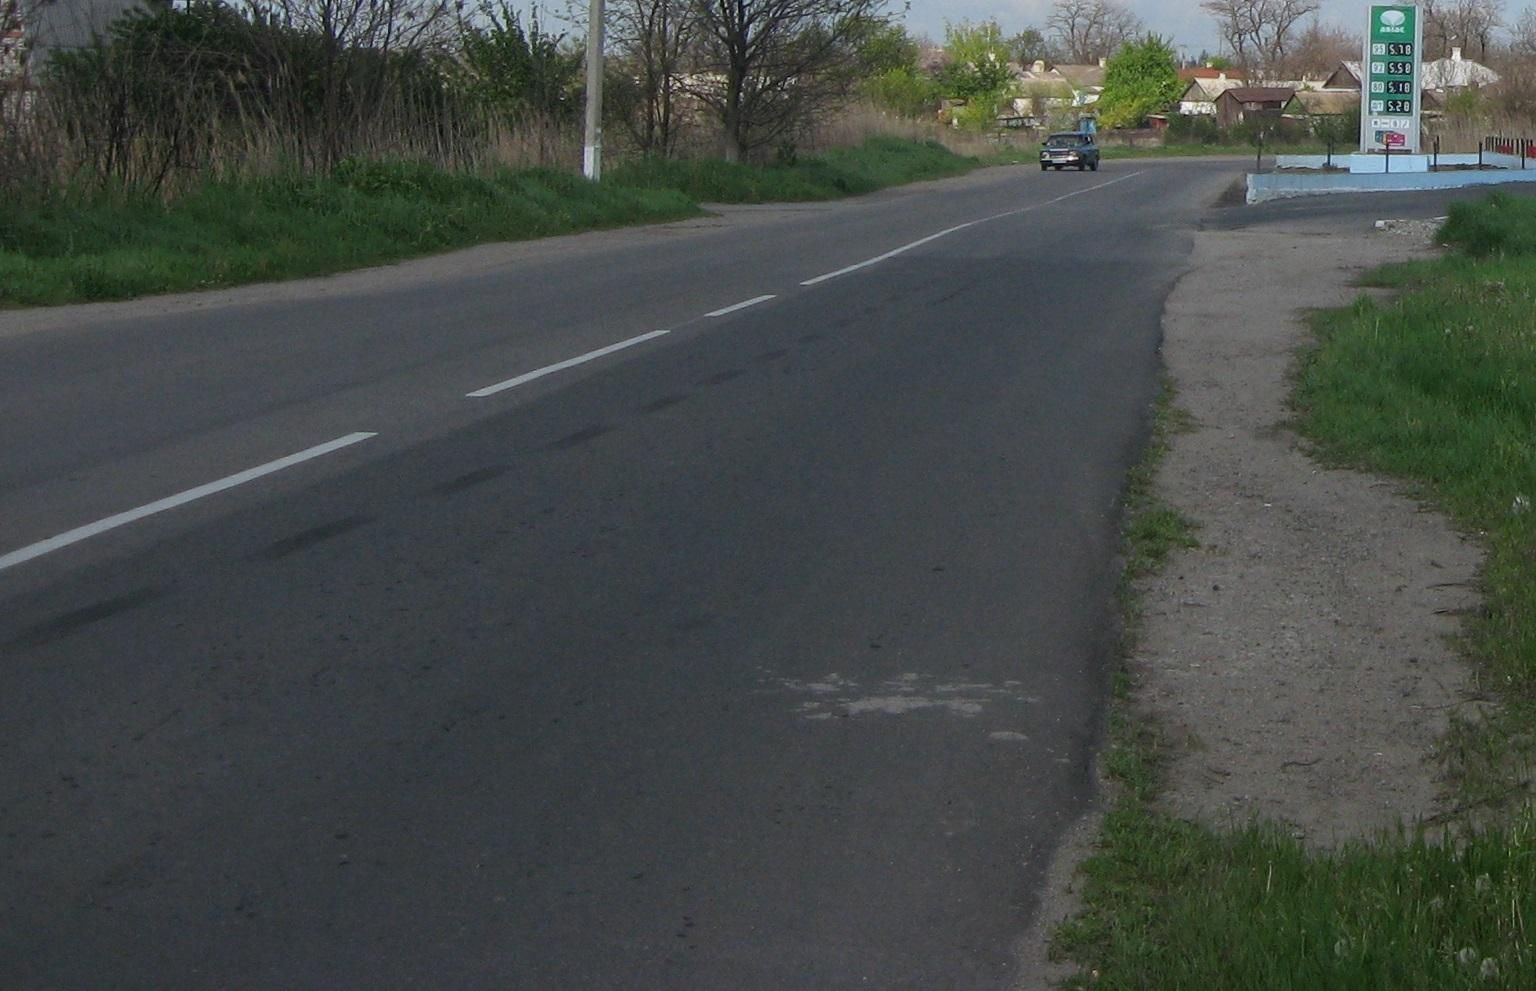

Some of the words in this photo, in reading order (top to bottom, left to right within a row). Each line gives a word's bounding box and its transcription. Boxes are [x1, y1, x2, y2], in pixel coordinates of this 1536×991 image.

[1374, 44, 1384, 54] 95
[1373, 63, 1383, 72] 92
[1373, 82, 1383, 91] 80
